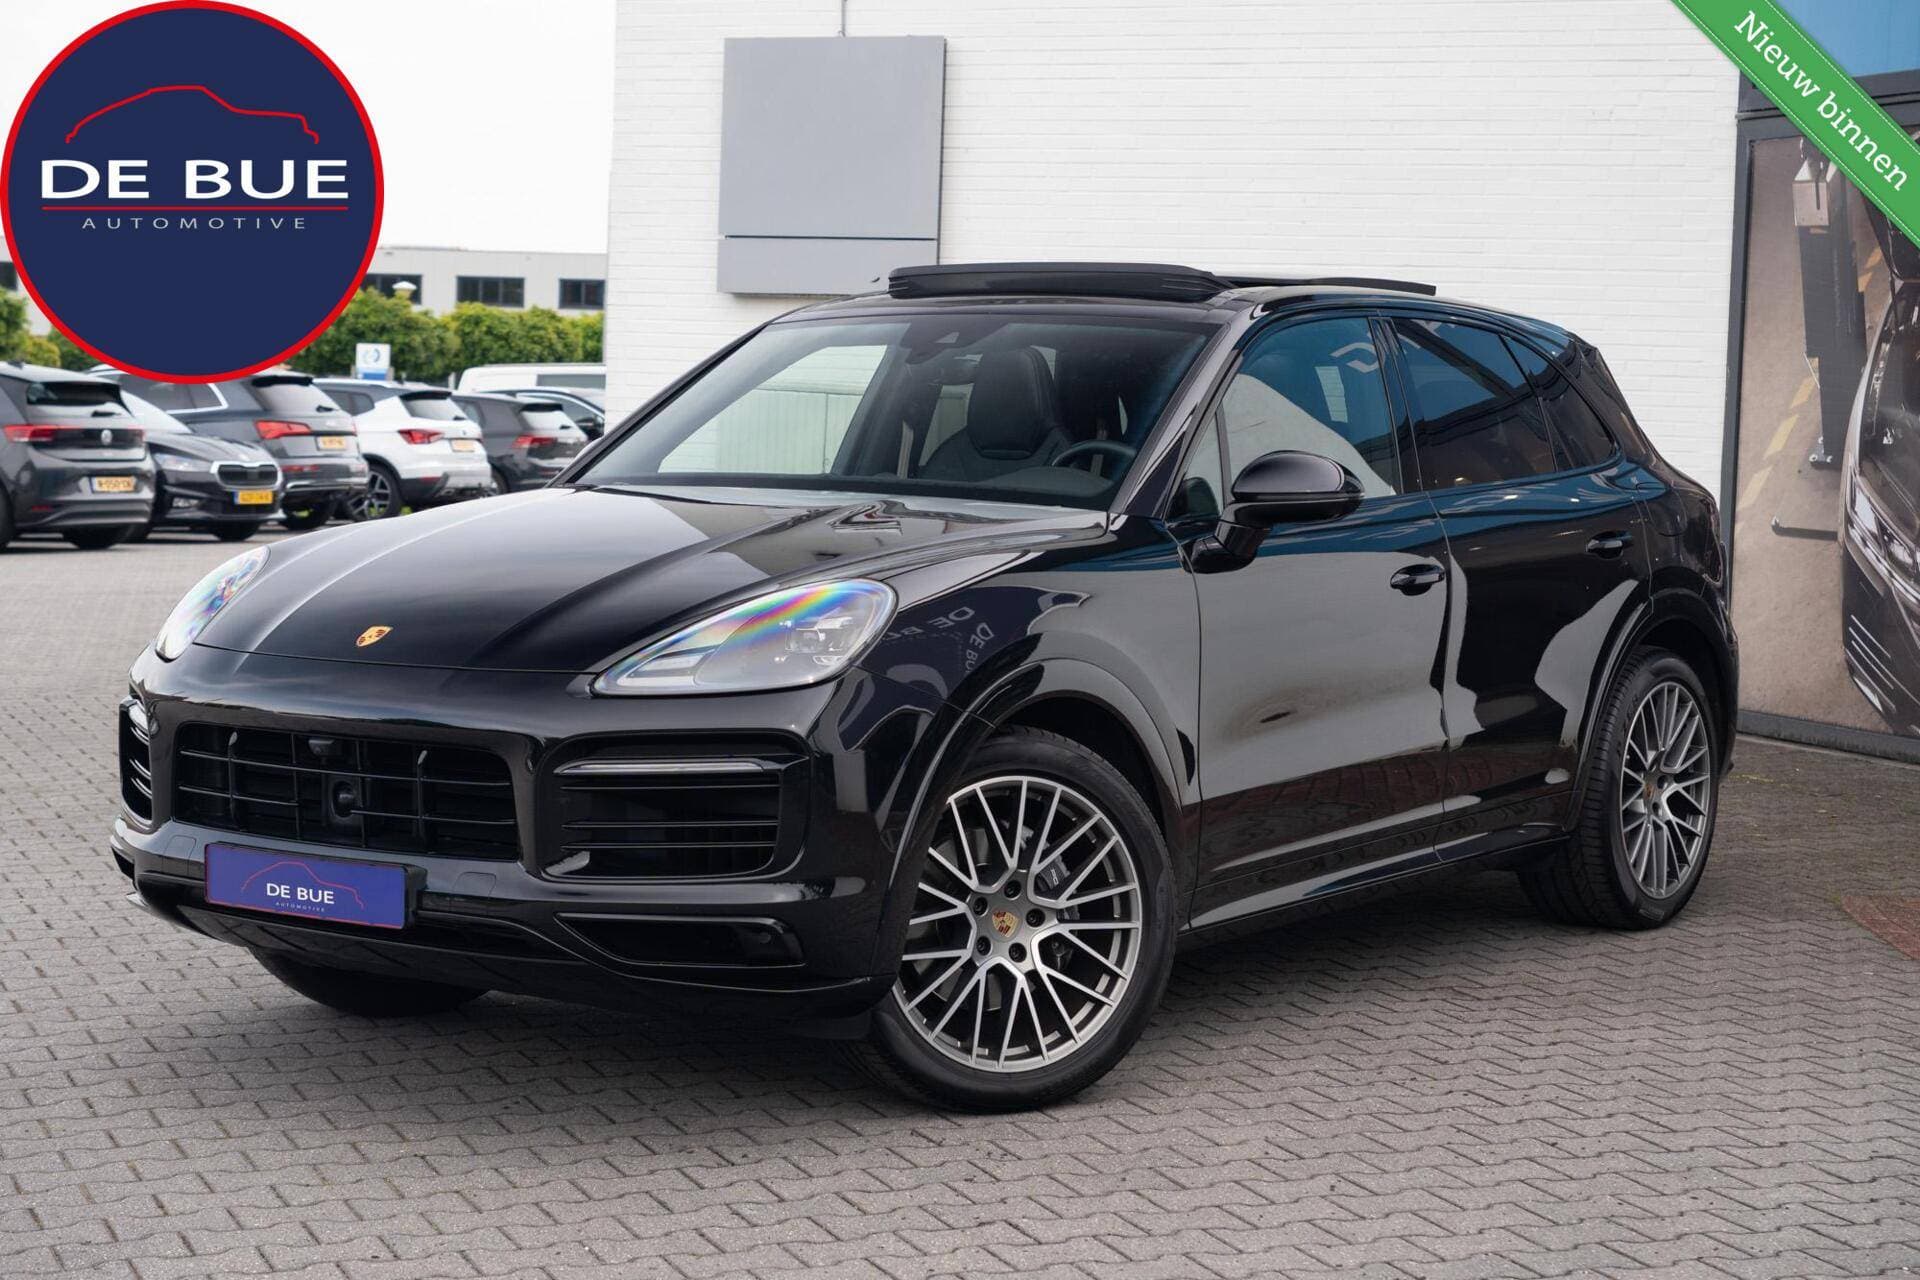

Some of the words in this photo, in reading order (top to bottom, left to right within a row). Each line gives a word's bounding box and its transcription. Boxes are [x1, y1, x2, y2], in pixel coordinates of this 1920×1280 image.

[266, 883, 290, 898] DE
[297, 886, 334, 904] BUE
[275, 901, 325, 912] AUTOMOTIVE
